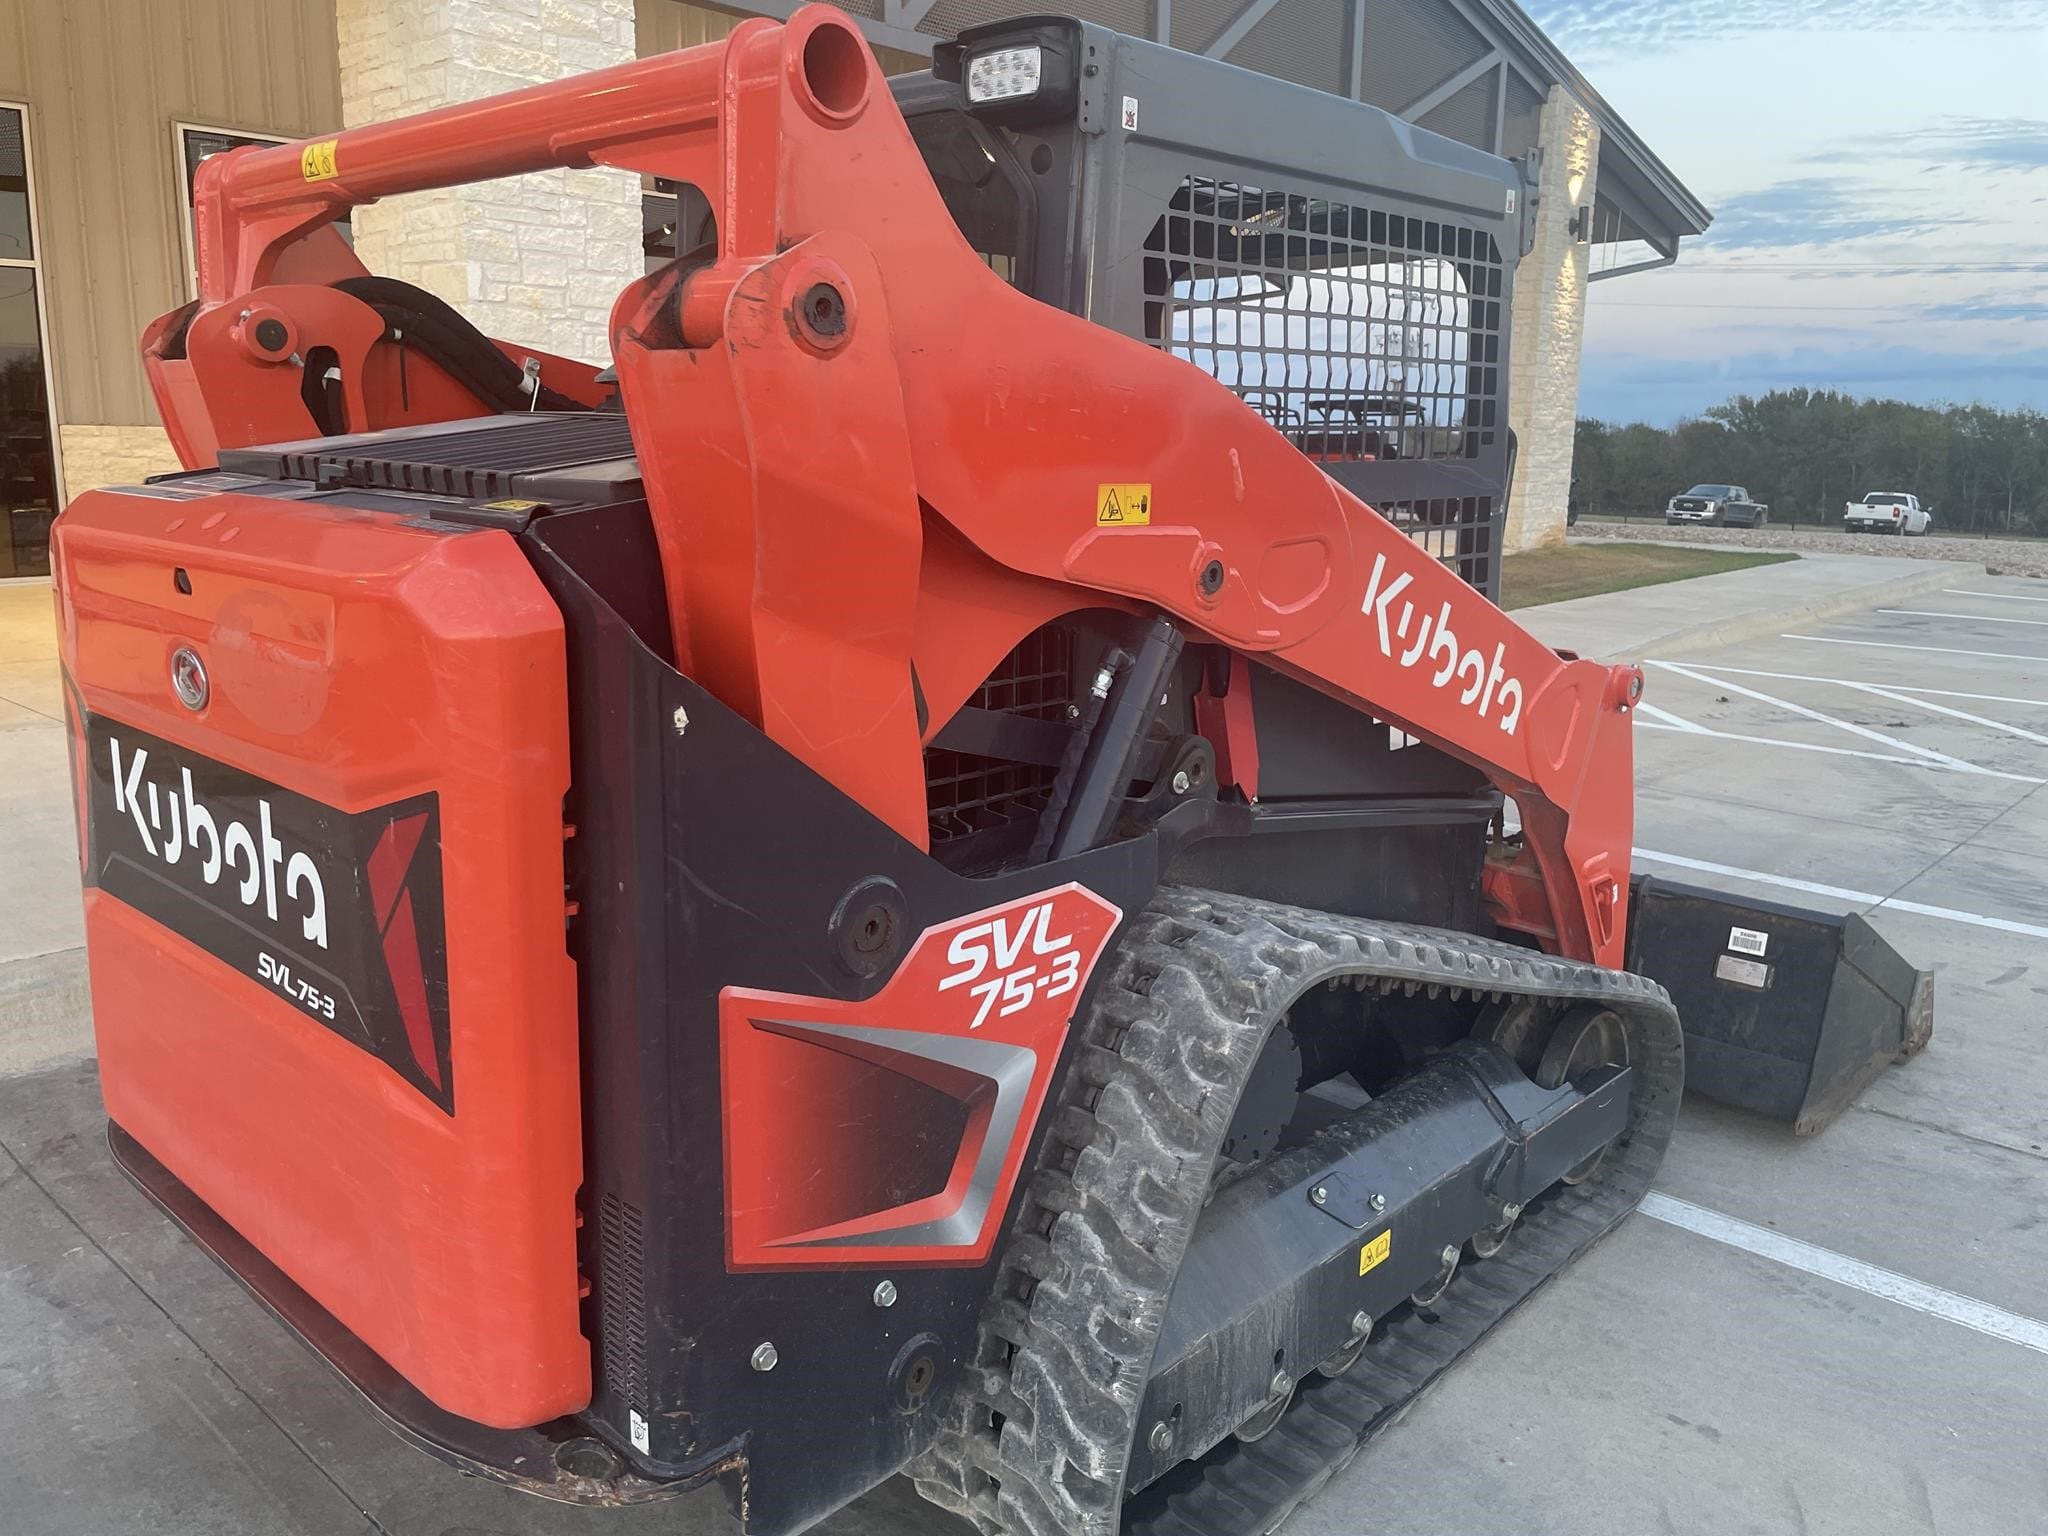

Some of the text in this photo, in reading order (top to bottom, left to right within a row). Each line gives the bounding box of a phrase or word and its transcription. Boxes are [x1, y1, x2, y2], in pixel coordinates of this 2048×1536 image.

[1361, 552, 1523, 736] Kubota
[110, 737, 328, 949] Kubota
[938, 902, 1073, 992] SVL
[969, 950, 1081, 1030] 75-3
